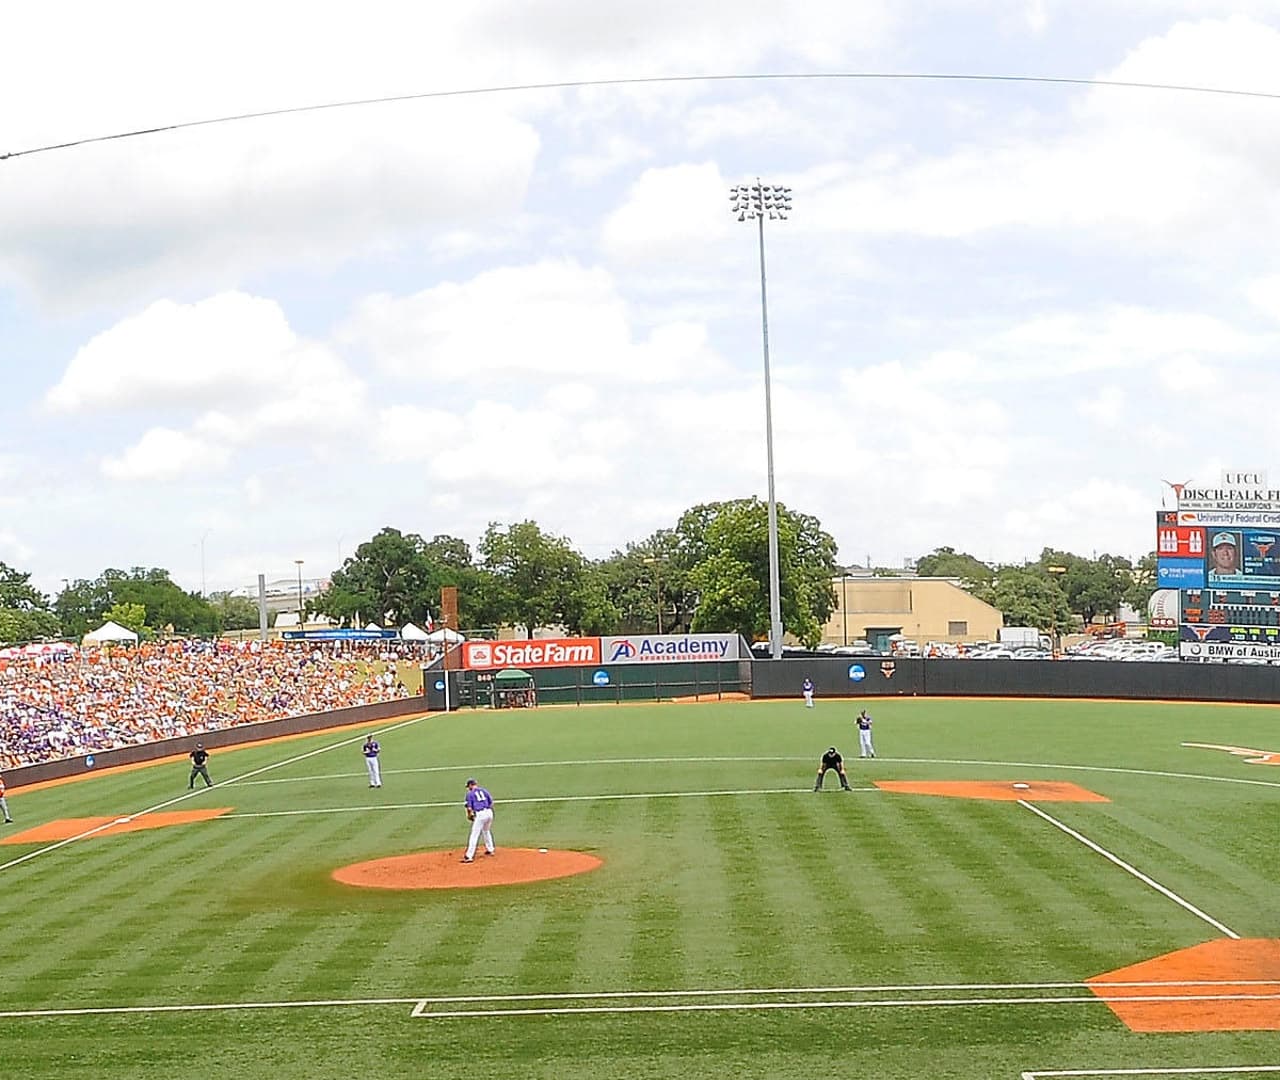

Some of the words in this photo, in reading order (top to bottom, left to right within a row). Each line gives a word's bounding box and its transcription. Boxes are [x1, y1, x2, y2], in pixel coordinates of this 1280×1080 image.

[1226, 473, 1263, 484] UFCU
[1184, 489, 1263, 500] DISCH-FALK
[1197, 513, 1234, 524] University
[1236, 513, 1261, 523] Federal
[640, 638, 729, 657] Academy
[1208, 645, 1234, 656] BMW
[1236, 646, 1247, 656] of
[474, 790, 486, 802] 11
